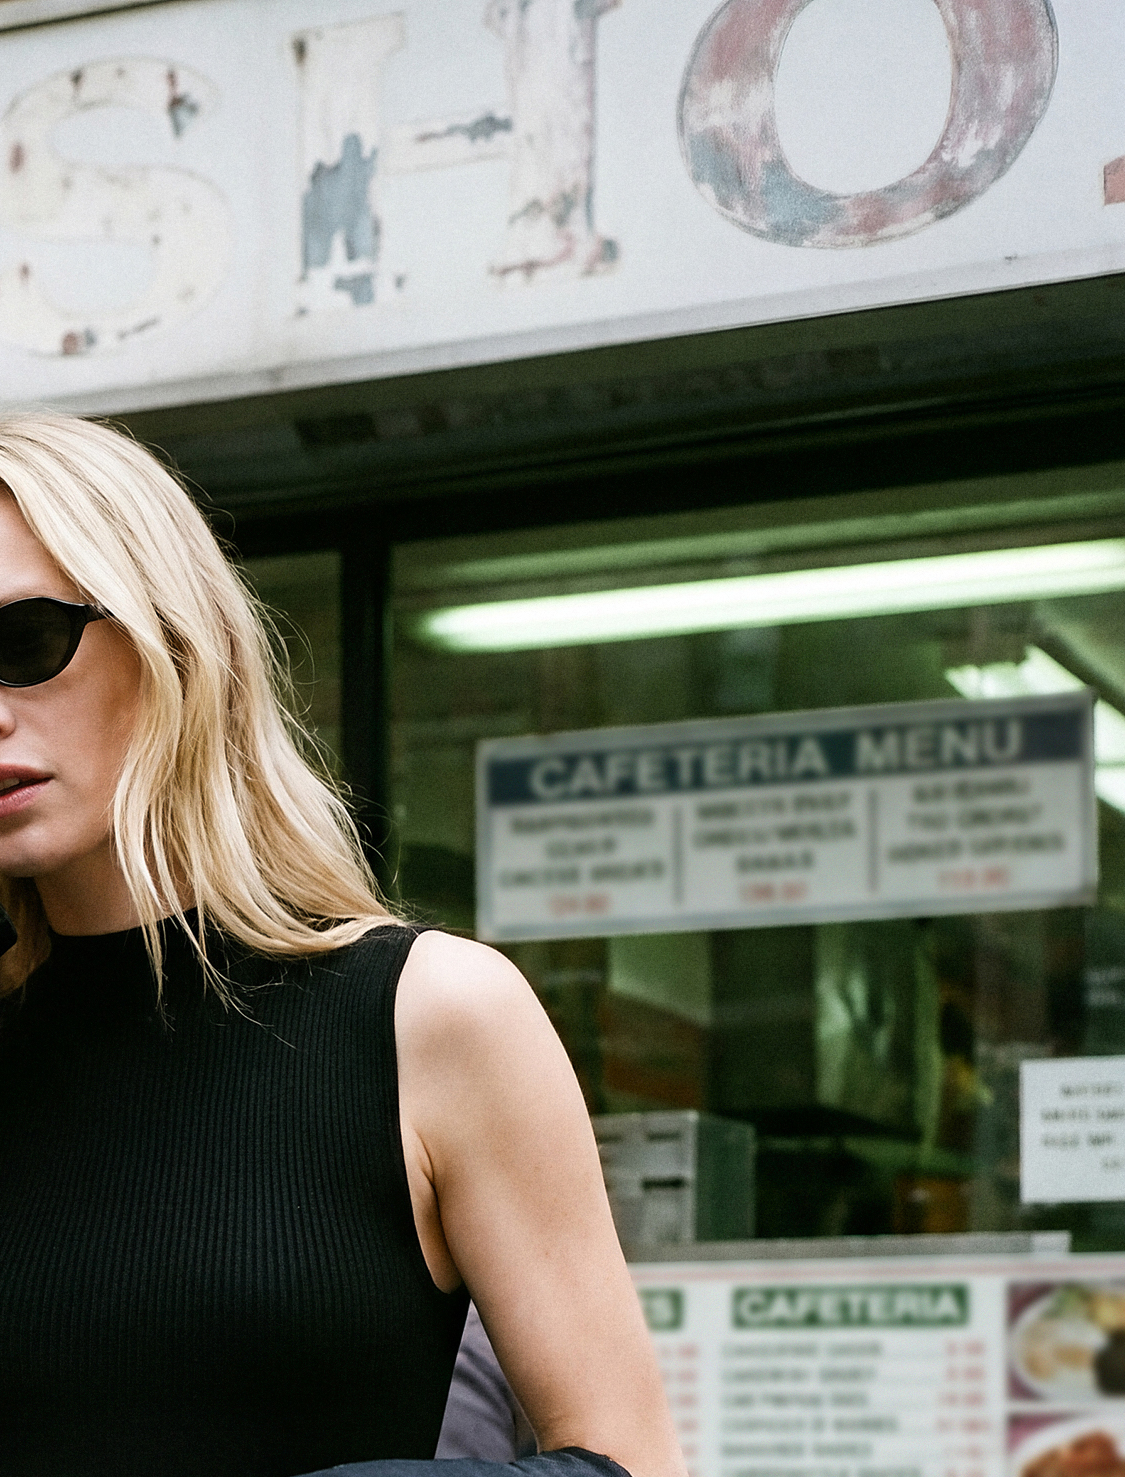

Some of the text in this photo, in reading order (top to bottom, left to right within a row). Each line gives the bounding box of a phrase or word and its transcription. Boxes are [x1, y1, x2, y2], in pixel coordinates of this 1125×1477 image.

[529, 717, 1023, 798] CAFETERIA MENU
[737, 1289, 961, 1322] CAFETERIA
